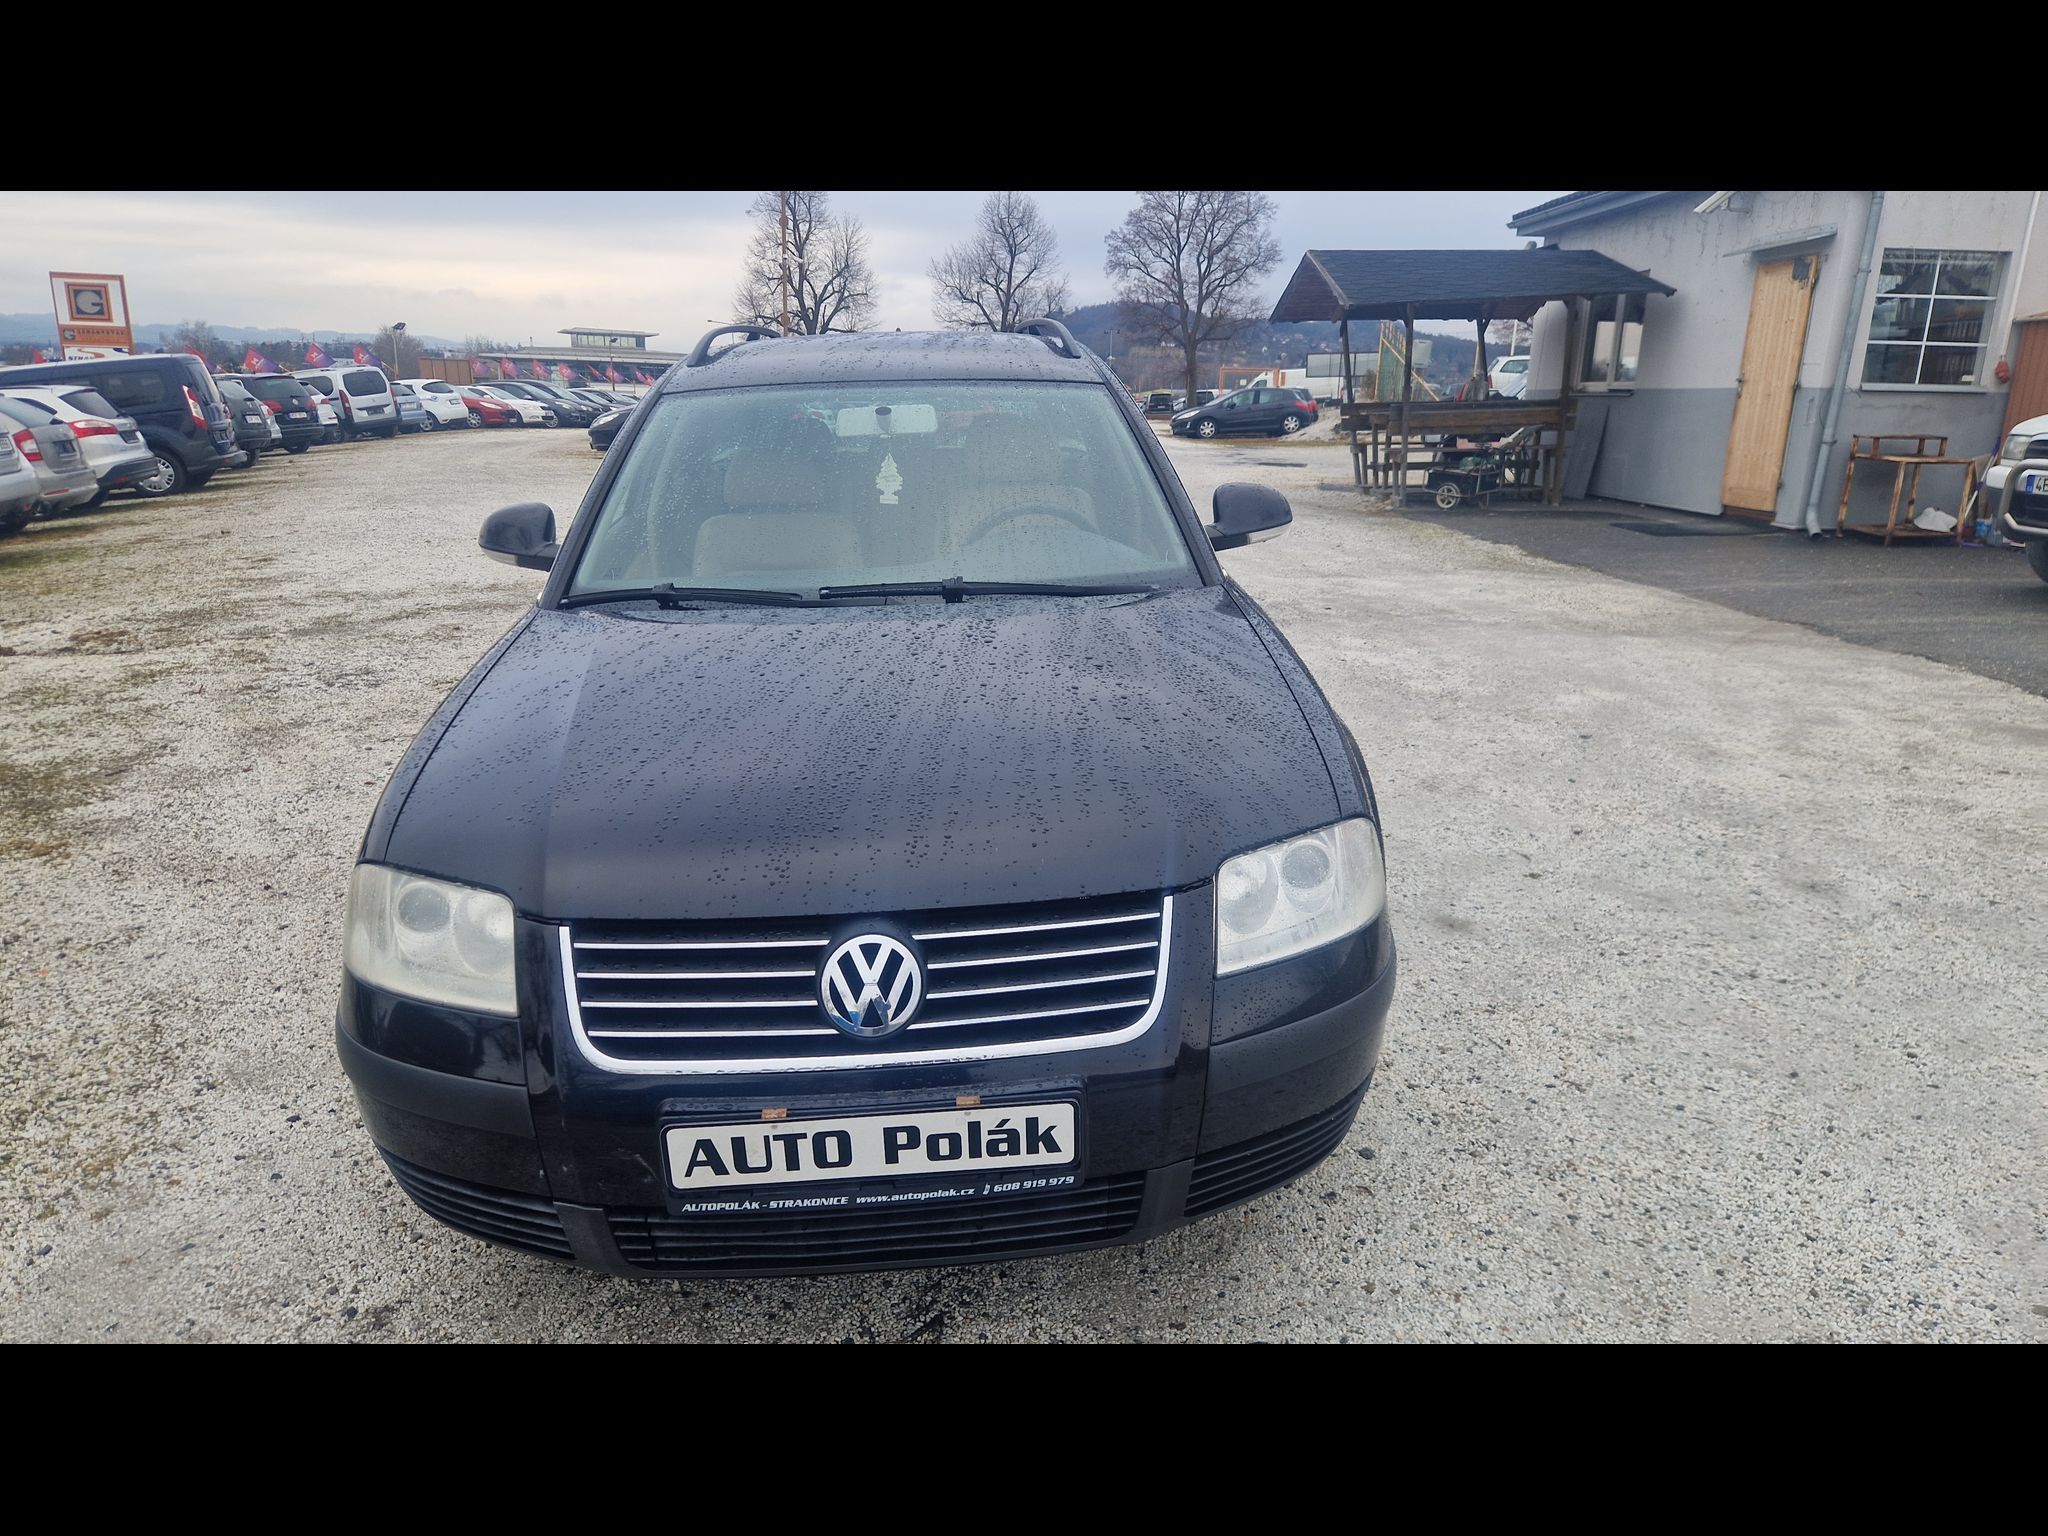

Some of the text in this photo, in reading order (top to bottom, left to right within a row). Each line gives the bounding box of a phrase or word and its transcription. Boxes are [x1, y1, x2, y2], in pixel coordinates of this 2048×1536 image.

[684, 1116, 1063, 1178] AUTO Polák
[682, 1199, 760, 1212] AUTOPOLÁK
[769, 1196, 849, 1209] STRAKONICE
[856, 1187, 975, 1204] www.autopolak.cz
[993, 1182, 1021, 1193] 608
[1022, 1179, 1047, 1189] 919
[1048, 1175, 1075, 1186] 979
